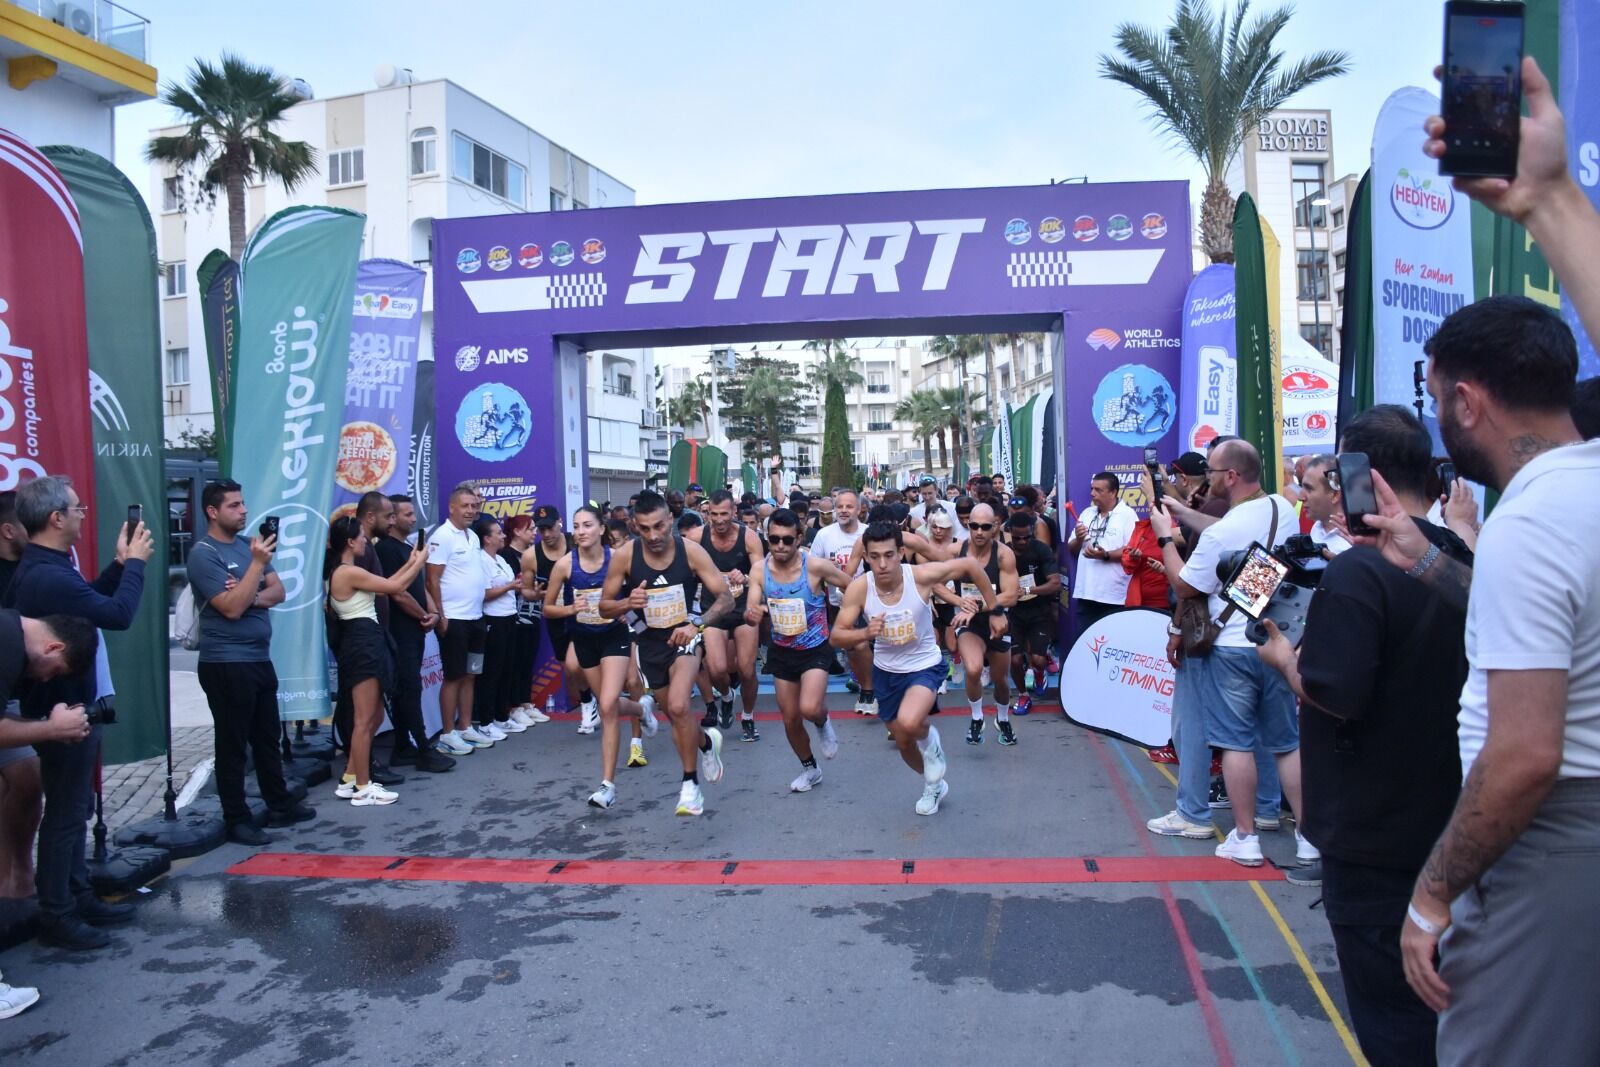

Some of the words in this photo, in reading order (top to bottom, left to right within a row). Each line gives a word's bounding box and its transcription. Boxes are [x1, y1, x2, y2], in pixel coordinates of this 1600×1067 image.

[1258, 118, 1328, 136] DOME
[1260, 136, 1328, 151] HOTEL
[1395, 184, 1447, 214] HEDİYEM
[624, 218, 987, 305] START
[1395, 258, 1414, 276] Her
[1124, 329, 1163, 338] WORLD
[1124, 339, 1181, 349] ATHLETICS
[485, 348, 529, 365] AIMS
[1204, 358, 1225, 416] Easy
[19, 361, 42, 457] companies
[422, 435, 432, 506] CONSTRUCTION
[496, 485, 537, 496] GROUP
[1121, 668, 1176, 696] TIMING
